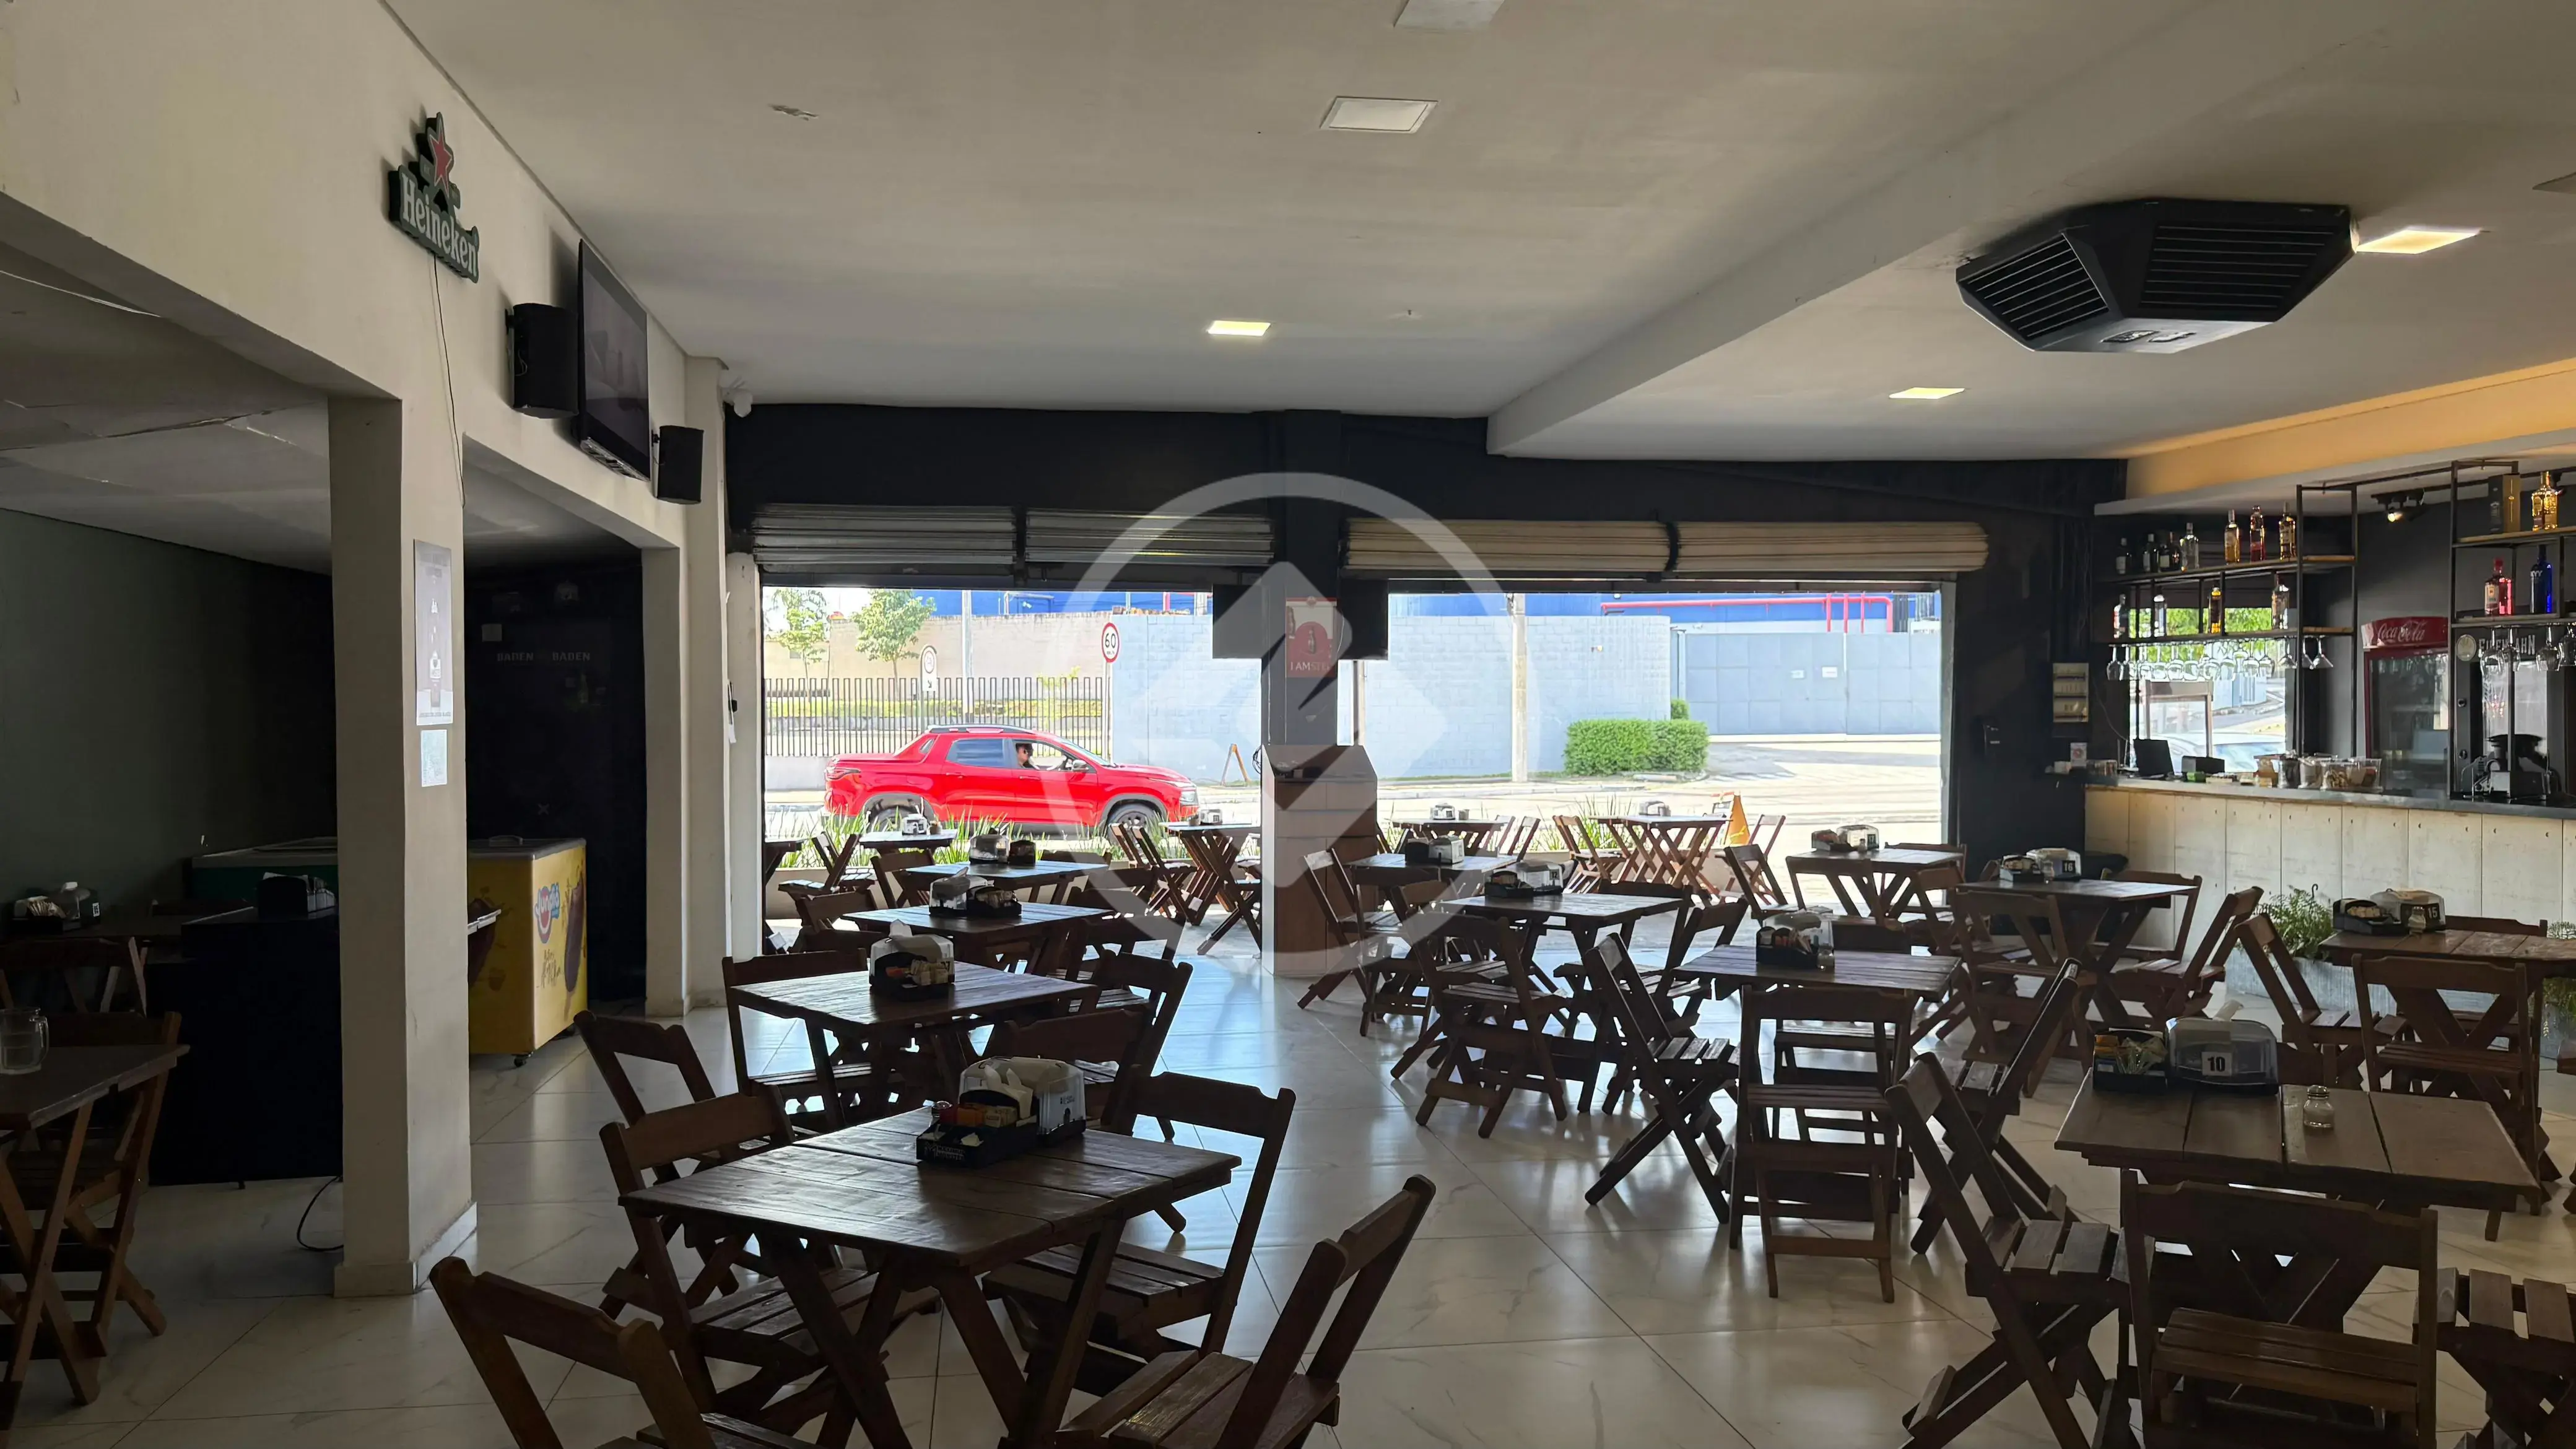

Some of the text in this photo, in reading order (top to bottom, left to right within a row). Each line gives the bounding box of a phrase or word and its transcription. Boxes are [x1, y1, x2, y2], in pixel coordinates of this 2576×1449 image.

[402, 172, 477, 277] Heineken
[1105, 633, 1116, 648] 60
[552, 651, 590, 661] BADEN
[2208, 1056, 2226, 1072] 10
